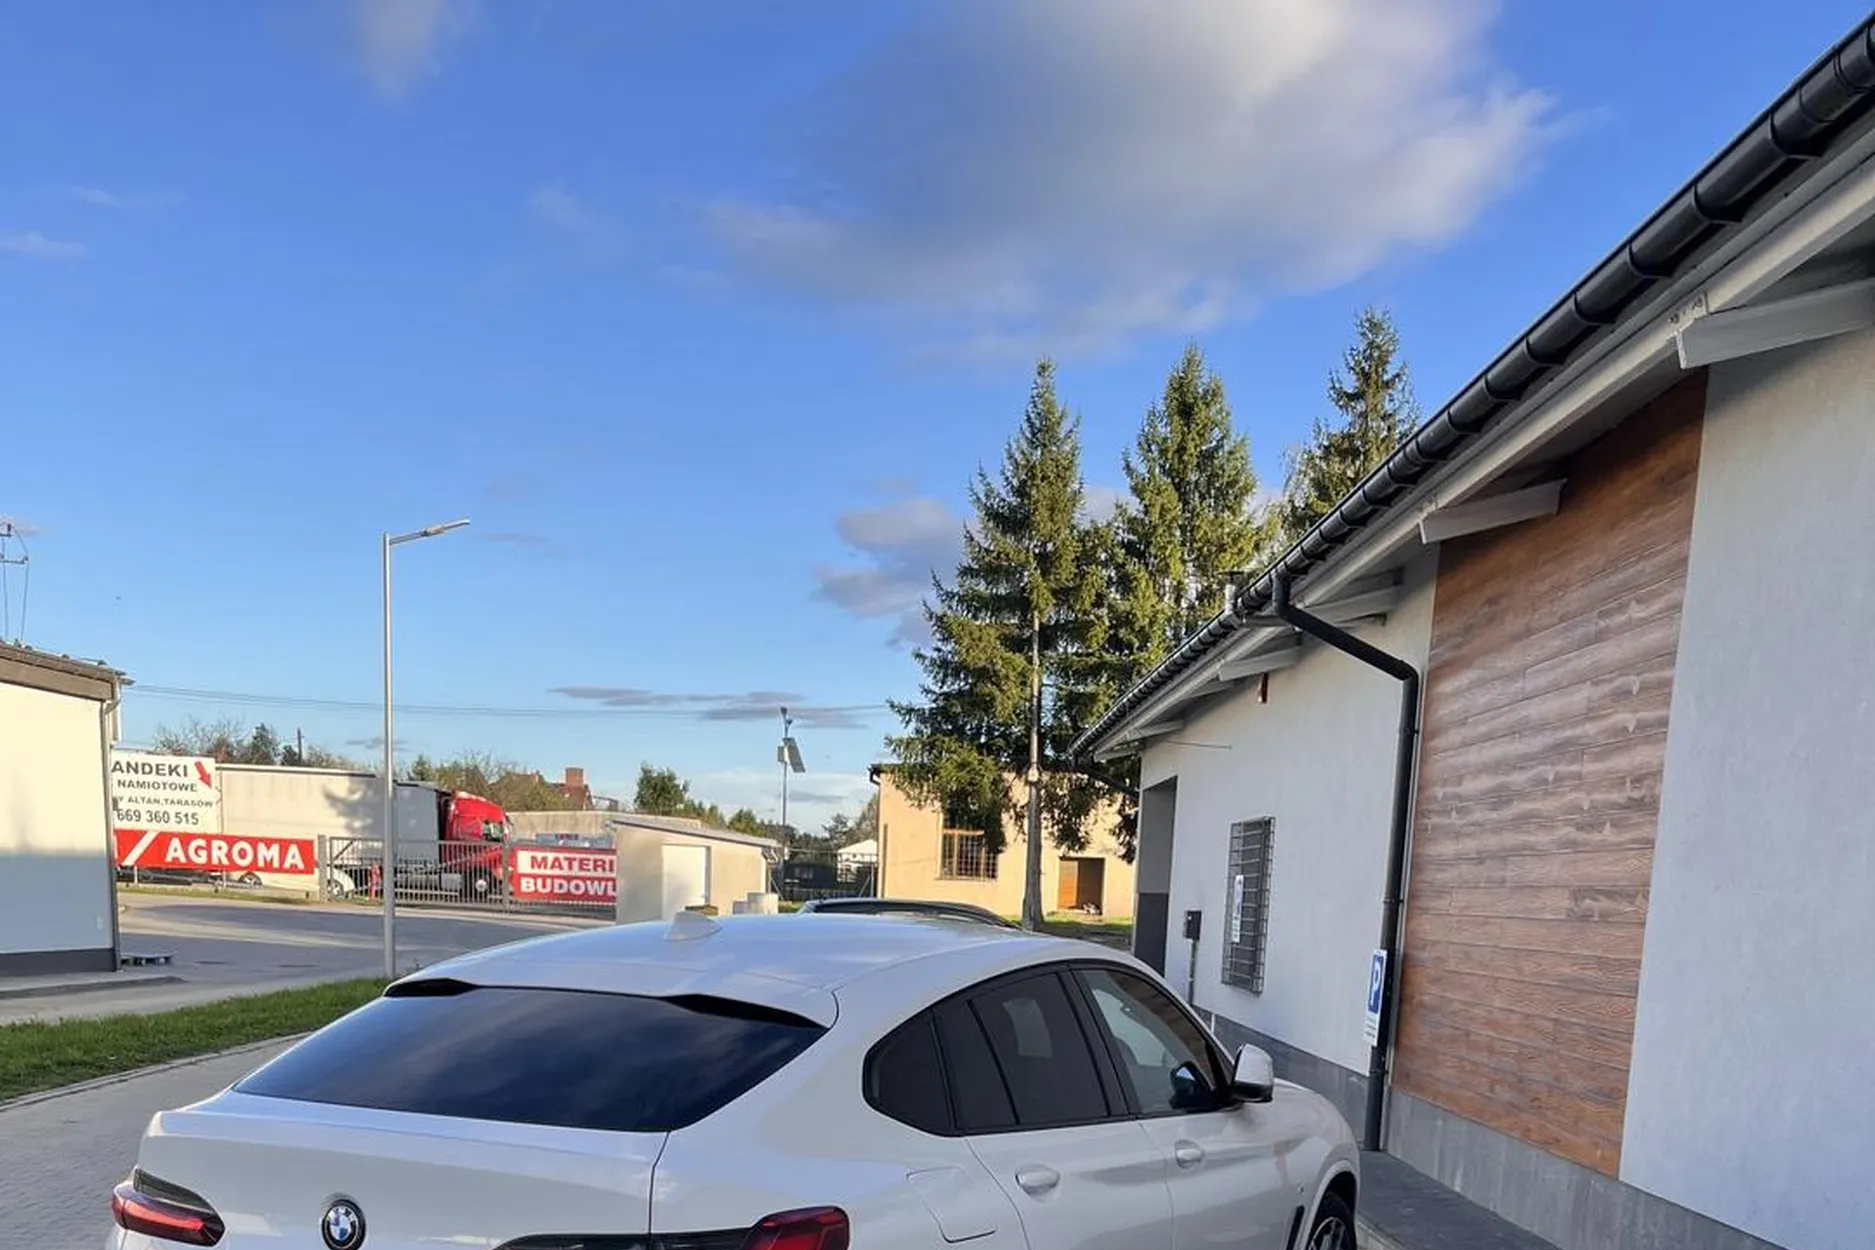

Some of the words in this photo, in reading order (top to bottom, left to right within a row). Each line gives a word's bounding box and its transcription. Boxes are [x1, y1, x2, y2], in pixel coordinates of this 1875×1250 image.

[111, 760, 187, 778] ANDEKI
[117, 779, 198, 792] NAMIOTOWE
[117, 809, 141, 822] 669
[145, 810, 170, 824] 360
[175, 812, 199, 826] 515
[165, 837, 305, 869] AGROMA
[530, 855, 614, 872] MATERI
